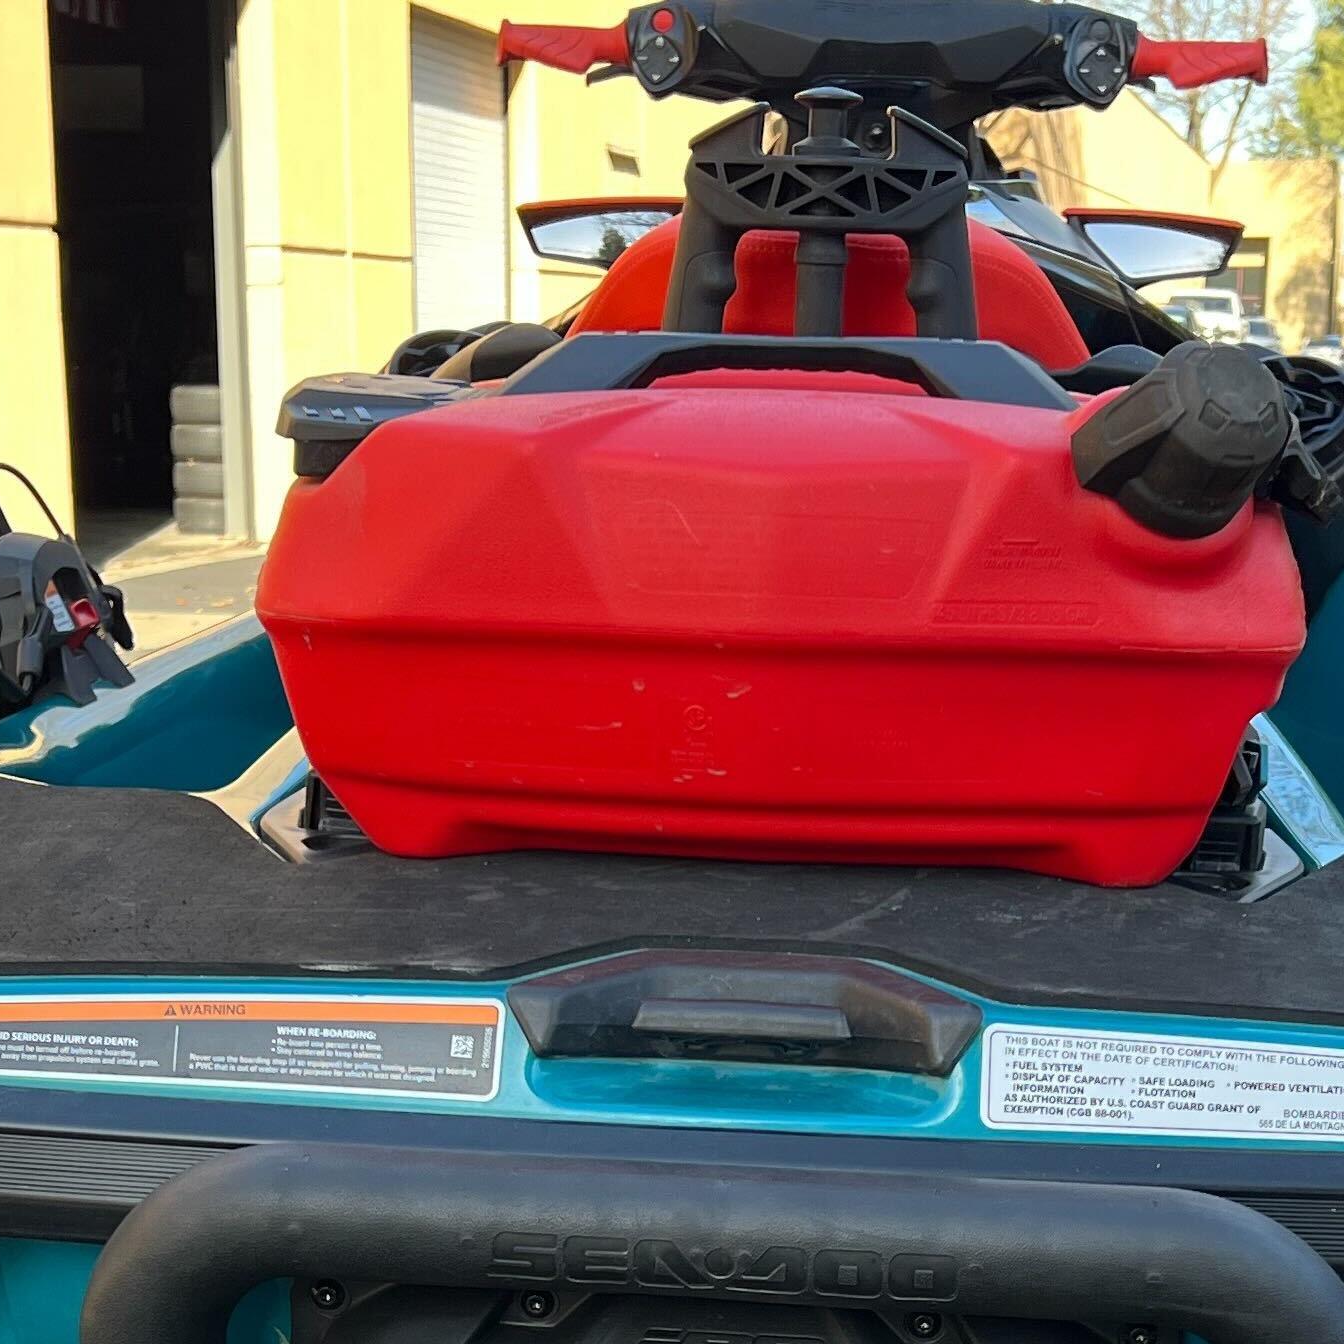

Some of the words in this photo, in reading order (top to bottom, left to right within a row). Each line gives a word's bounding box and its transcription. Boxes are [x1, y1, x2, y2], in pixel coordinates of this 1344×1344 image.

[180, 1004, 246, 1016] WARNING
[276, 1026, 306, 1036] WHEN
[307, 1028, 376, 1039] RE-BOARDING:
[11, 1032, 51, 1042] SERIOUS
[52, 1034, 87, 1044] INJURY
[88, 1036, 102, 1045] OR
[103, 1036, 138, 1046] DEATH:
[1005, 1036, 1028, 1046] THIS
[1031, 1038, 1060, 1048] BOAT
[1062, 1040, 1073, 1049] IS
[1075, 1041, 1097, 1051] NOT
[1100, 1043, 1157, 1055] REQUIRED
[1160, 1047, 1175, 1056] TO
[1177, 1048, 1222, 1060] COMPLY
[1224, 1052, 1252, 1063] WITH
[1256, 1054, 1276, 1065] THE
[1279, 1056, 1344, 1070] FOLLOWING
[1004, 1048, 1015, 1057] IN
[1017, 1049, 1058, 1060] EFFECT
[1061, 1051, 1077, 1061] ON
[1080, 1052, 1101, 1063] THE
[1103, 1054, 1132, 1065] DATE
[1134, 1056, 1150, 1066] OF
[1152, 1057, 1238, 1073] CERTIFICATION:
[1012, 1061, 1038, 1071] FUEL
[1040, 1063, 1083, 1072] SYSTEM
[1011, 1073, 1054, 1083] DISPLAY
[1057, 1075, 1070, 1084] OF
[1073, 1075, 1125, 1086] CAPACITY
[1138, 1077, 1165, 1087] SAFE
[1168, 1079, 1215, 1088] LOADING
[1012, 1084, 1084, 1095] INFORMATION
[1233, 1081, 1285, 1093] POWERED
[1138, 1088, 1196, 1099] FLOTATION
[1004, 1093, 1017, 1103] AS
[1020, 1094, 1087, 1106] AUTHORIZED
[1089, 1098, 1104, 1107] BY
[1106, 1099, 1126, 1108] U.S.
[1129, 1100, 1165, 1110] COAST
[1167, 1101, 1205, 1111] GUARD
[1207, 1103, 1244, 1113] GRANT
[1246, 1104, 1261, 1114] OF
[1003, 1105, 1064, 1117] EXEMPTION
[1066, 1108, 1092, 1119] (CGB
[1258, 1120, 1273, 1129] 565
[1274, 1120, 1287, 1130] DE
[1289, 1121, 1301, 1130] LA
